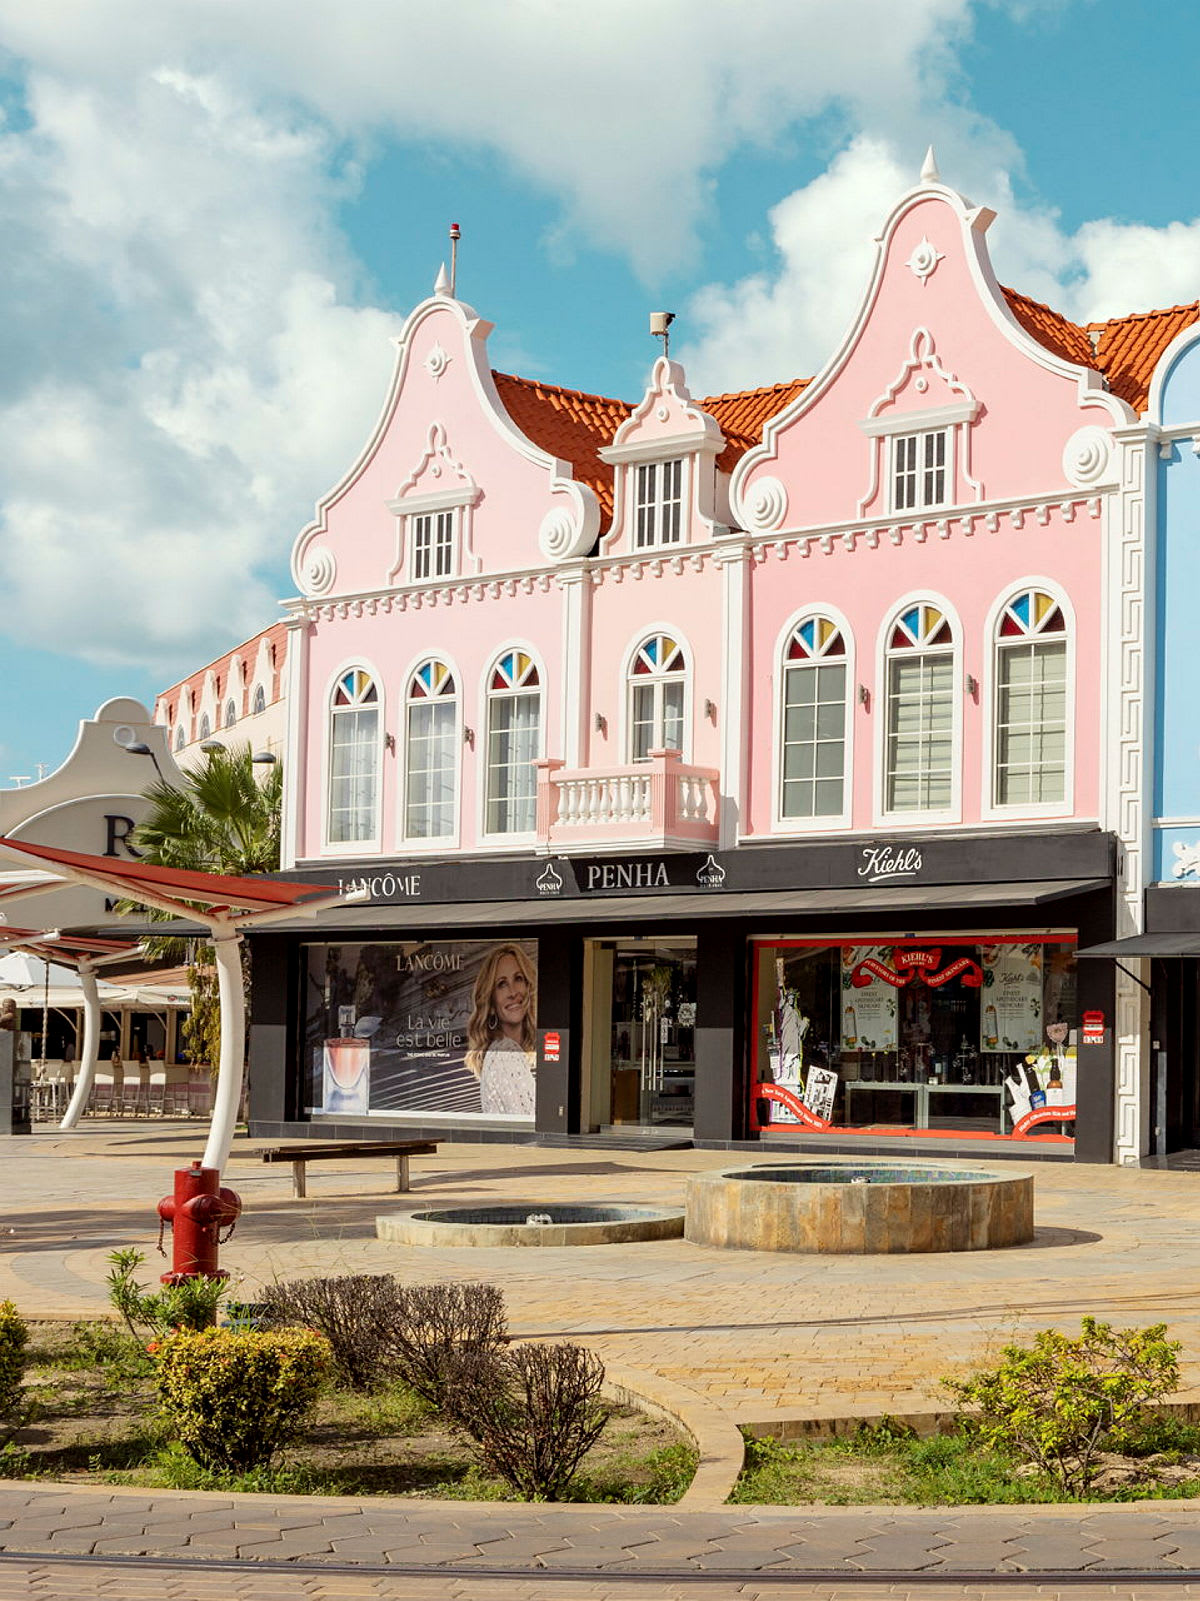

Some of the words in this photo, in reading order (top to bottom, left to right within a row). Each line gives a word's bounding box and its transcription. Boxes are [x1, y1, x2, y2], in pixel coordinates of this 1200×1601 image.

[858, 847, 922, 877] Kiehl's
[588, 862, 670, 889] PENHA
[396, 951, 465, 972] LANCÔME
[901, 952, 933, 964] KIEHL'S
[408, 1014, 424, 1030] La
[428, 1015, 451, 1030] vie
[396, 1032, 423, 1048] est
[426, 1031, 462, 1048] belle
